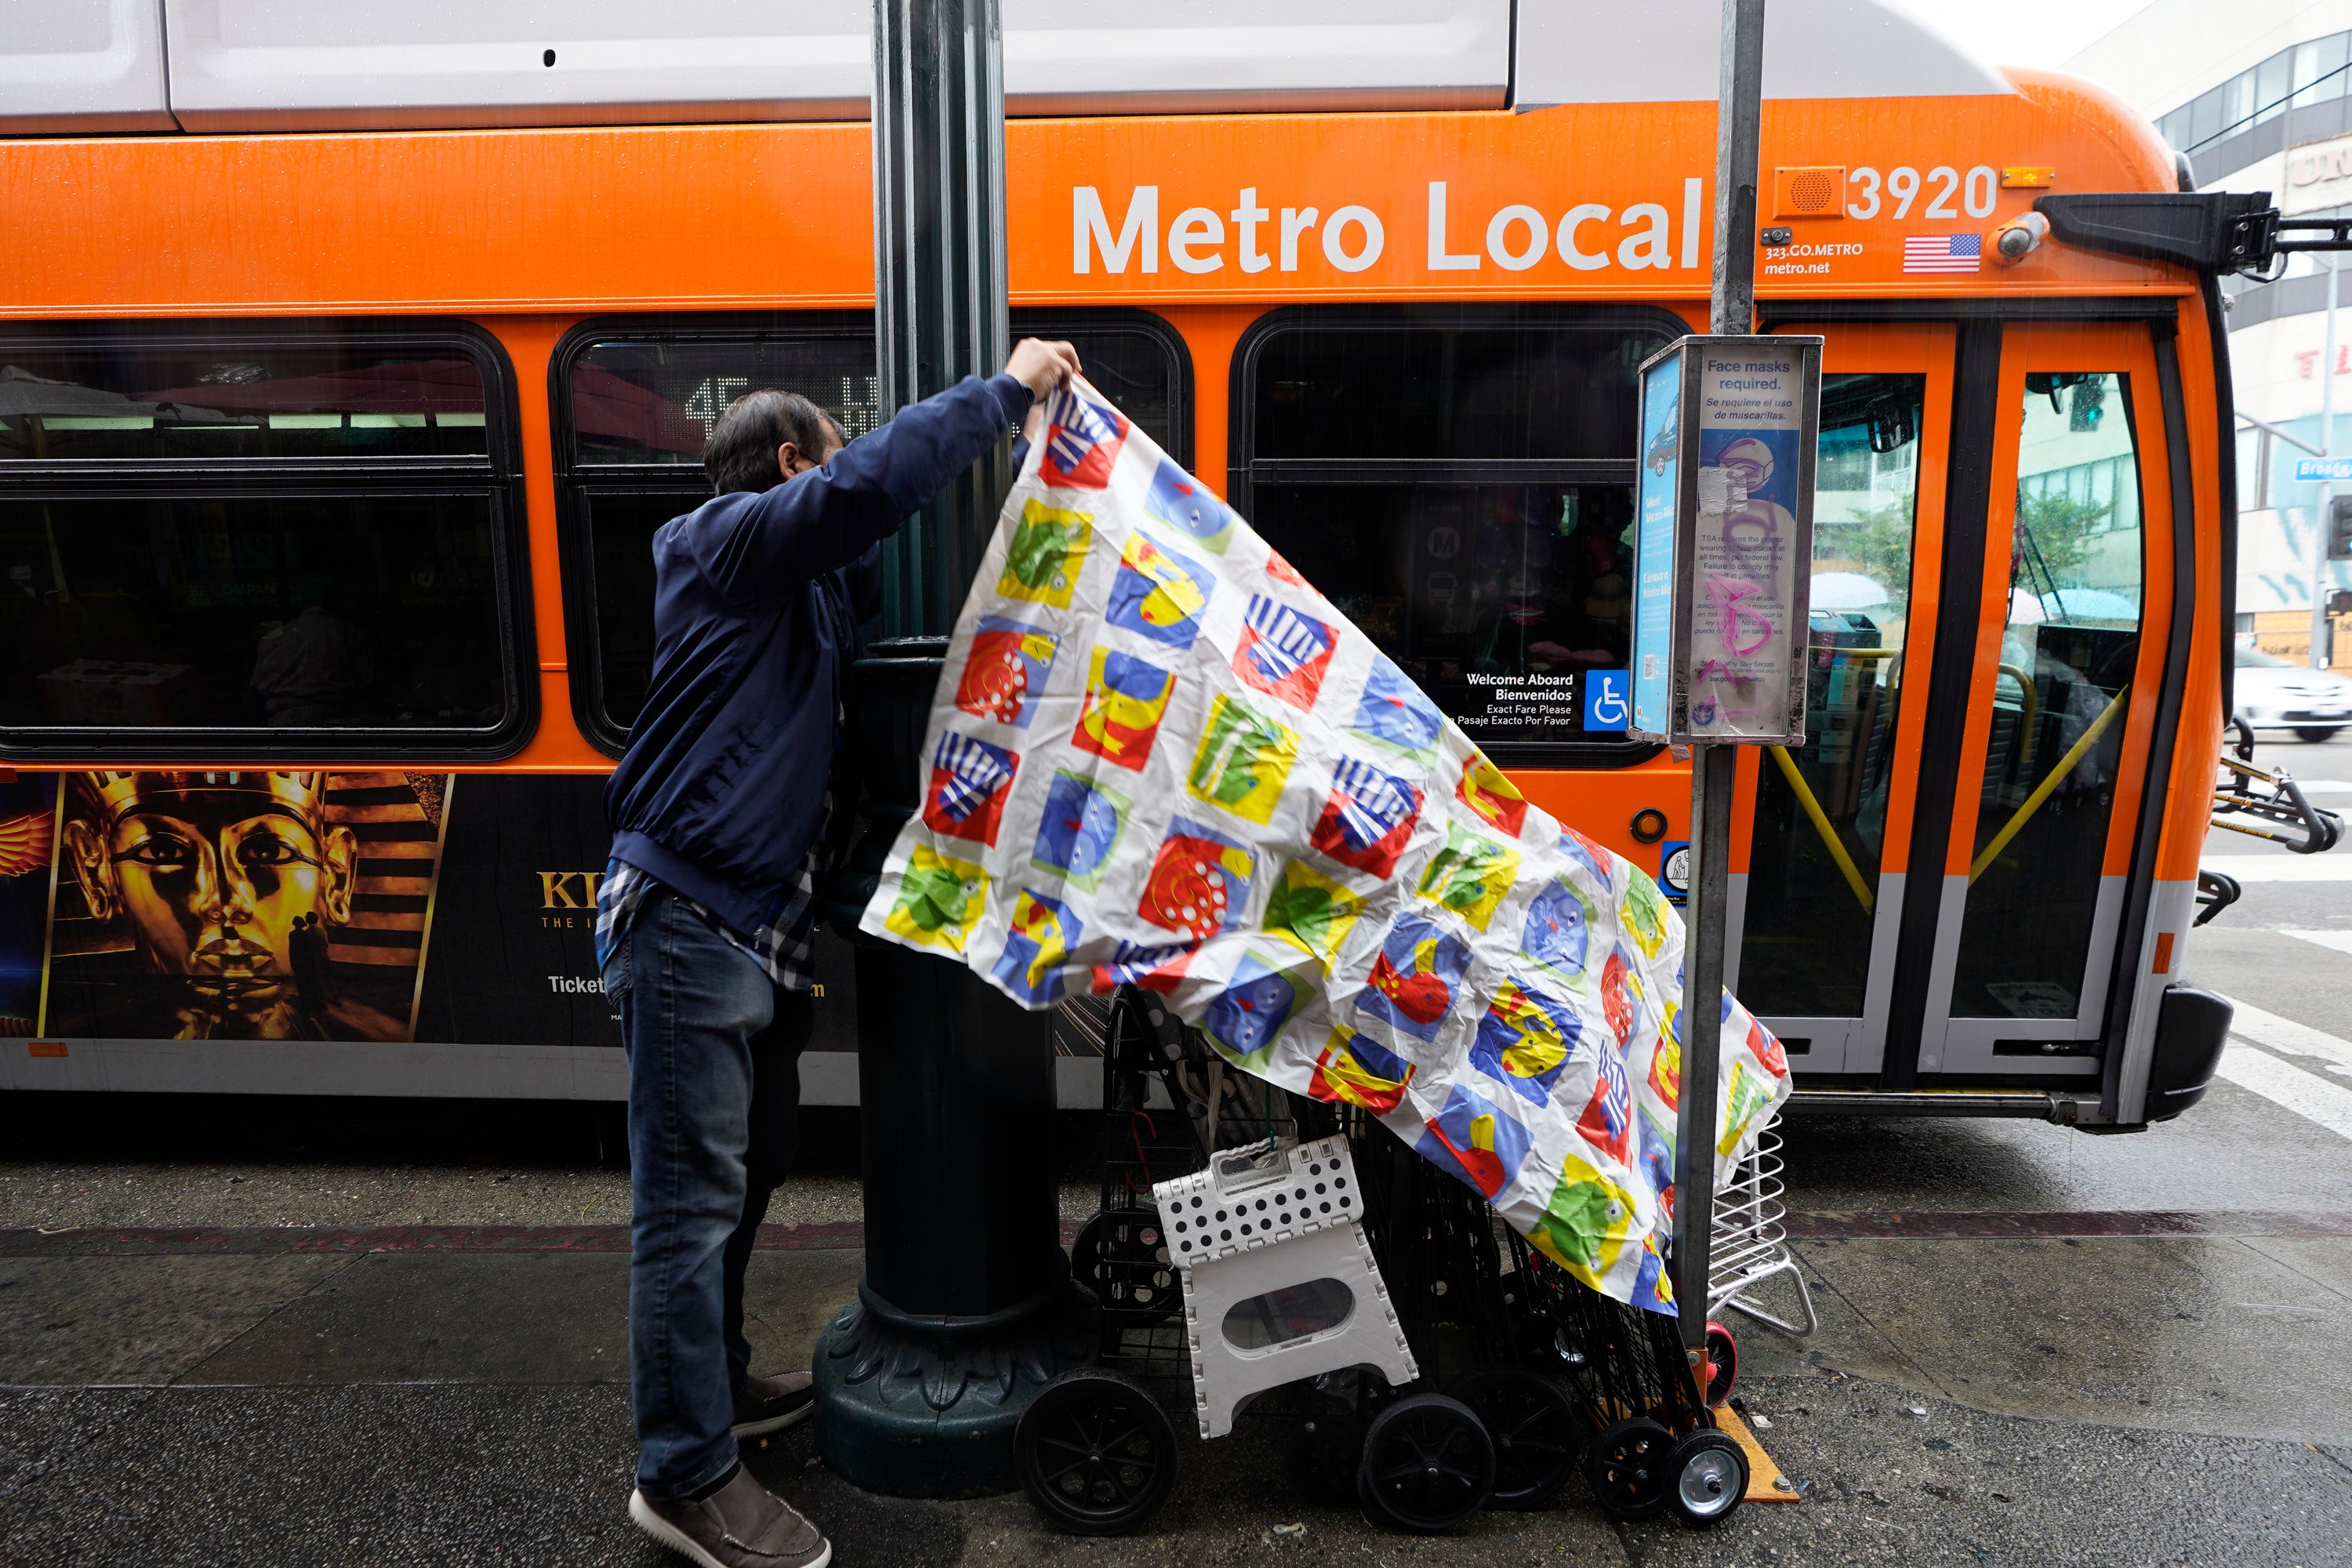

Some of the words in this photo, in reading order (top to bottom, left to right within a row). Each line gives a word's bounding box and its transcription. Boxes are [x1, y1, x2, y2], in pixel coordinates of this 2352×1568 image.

[1848, 165, 1997, 220] 3920
[1073, 185, 1385, 274] Metro
[1427, 178, 1702, 270] Local
[1766, 244, 1863, 260] 323.GO.METRO
[1765, 262, 1830, 274] metro.net
[1708, 361, 1740, 372] Face
[1745, 361, 1790, 372] masks
[1719, 378, 1781, 392] required.
[1721, 398, 1761, 407] requiere
[1729, 412, 1786, 420] mascarillas.
[2299, 462, 2352, 477] Broadw
[1646, 510, 1663, 523] Metro
[1664, 506, 1675, 518] Mic
[1699, 545, 1726, 554] wearing
[1643, 586, 1660, 598] Metro
[1739, 660, 1753, 670] Stay
[1467, 673, 1525, 685] Welcome
[1527, 673, 1573, 685] Aboard
[1495, 688, 1572, 701] Bienvenidos
[1486, 704, 1512, 713] Exact
[1515, 704, 1537, 713] Fare
[1539, 705, 1572, 714] Please
[1457, 716, 1489, 727] Pasaje
[1491, 716, 1523, 725] Exacto
[1525, 716, 1542, 725] Por
[1544, 716, 1570, 725] Favor
[536, 872, 605, 909] KI
[541, 917, 573, 928] THE
[548, 975, 605, 993] Ticket
